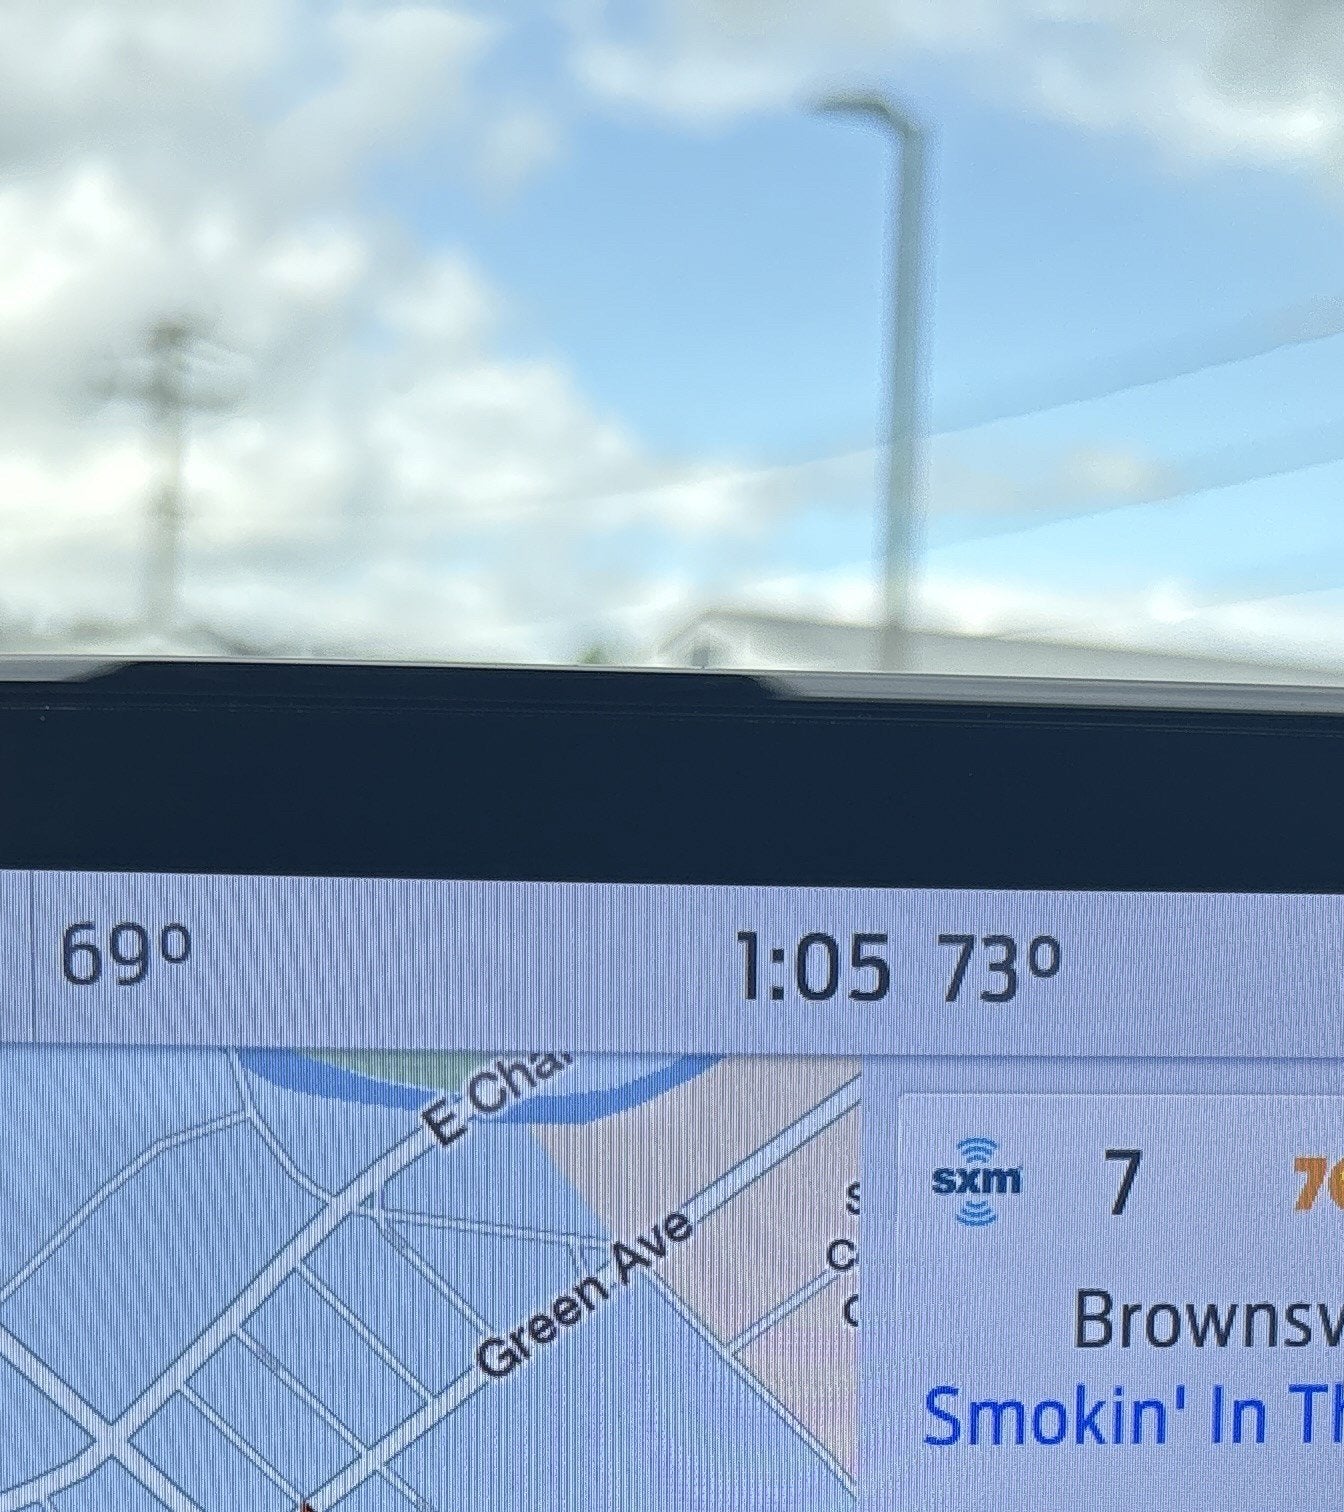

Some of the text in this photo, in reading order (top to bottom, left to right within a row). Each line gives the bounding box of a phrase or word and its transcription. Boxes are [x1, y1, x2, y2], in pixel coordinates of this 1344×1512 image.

[737, 930, 893, 1003] 1:05
[422, 1097, 469, 1147] E
[932, 1168, 1022, 1194] sxm
[1105, 1149, 1144, 1217] 7
[477, 1211, 694, 1378] Green Ave
[923, 1384, 1187, 1447] Smokin'
[1212, 1384, 1268, 1445] In
